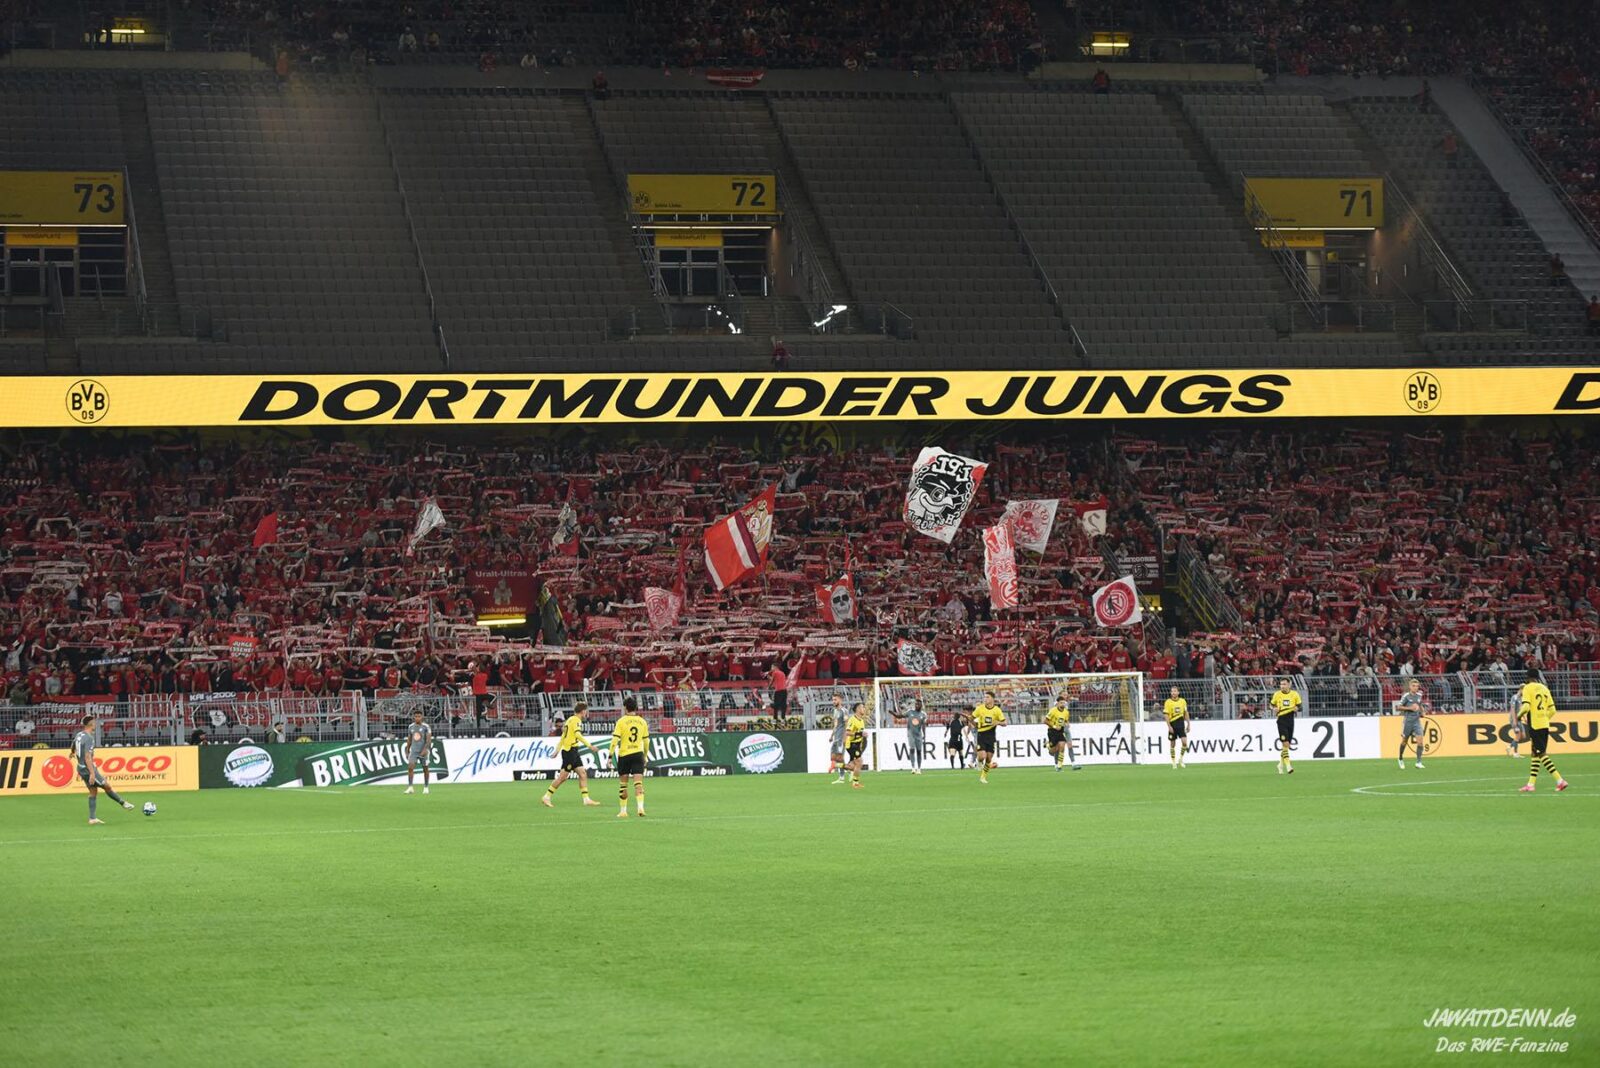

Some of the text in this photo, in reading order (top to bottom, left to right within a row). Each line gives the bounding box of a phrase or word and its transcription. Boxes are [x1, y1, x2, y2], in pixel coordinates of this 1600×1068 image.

[74, 184, 115, 213] 73
[732, 182, 766, 206] 72
[1340, 190, 1372, 217] 71
[72, 384, 105, 411] BVB
[238, 374, 1291, 421] DORTMUNDER JUNGS
[1408, 376, 1438, 401] BVB
[82, 410, 94, 420] 09
[1417, 400, 1429, 410] 09
[628, 726, 639, 743] 3
[579, 735, 705, 770] BRHOFF's
[894, 741, 936, 760] WR
[311, 741, 441, 787] BRINKHO's
[554, 770, 579, 779] bin
[667, 767, 694, 777] bwin
[700, 766, 727, 776] bwin
[521, 771, 548, 780] bwin
